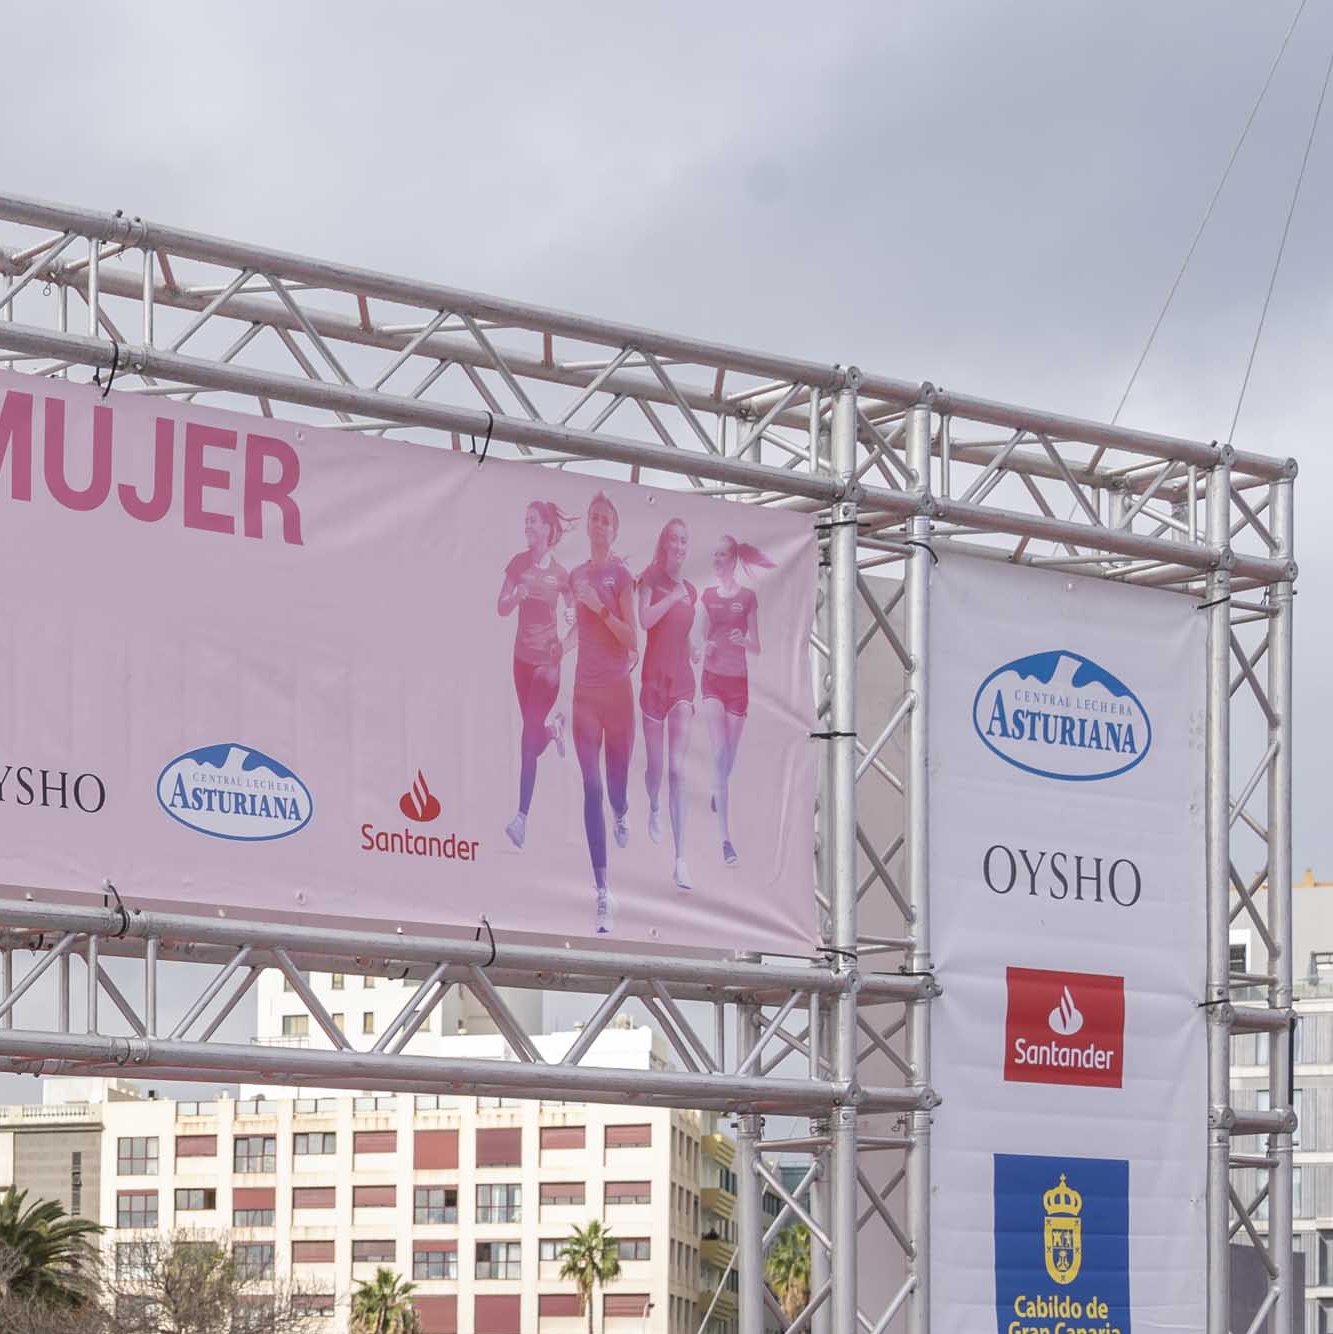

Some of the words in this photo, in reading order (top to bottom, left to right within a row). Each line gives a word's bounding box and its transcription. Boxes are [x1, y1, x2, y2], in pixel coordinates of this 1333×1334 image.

[1014, 690, 1071, 707] CENTRAL
[1077, 696, 1132, 716] LECHERA
[986, 689, 1137, 754] ASTURIANA
[170, 772, 302, 821] ASTURIANA
[192, 773, 240, 787] CENTRAL
[246, 777, 296, 792] LECHERA
[362, 824, 478, 861] Santander
[983, 845, 1141, 907] OYSHO
[1014, 1038, 1114, 1069] Santander
[1014, 1295, 1081, 1319] Cabildo
[1086, 1297, 1108, 1319] de
